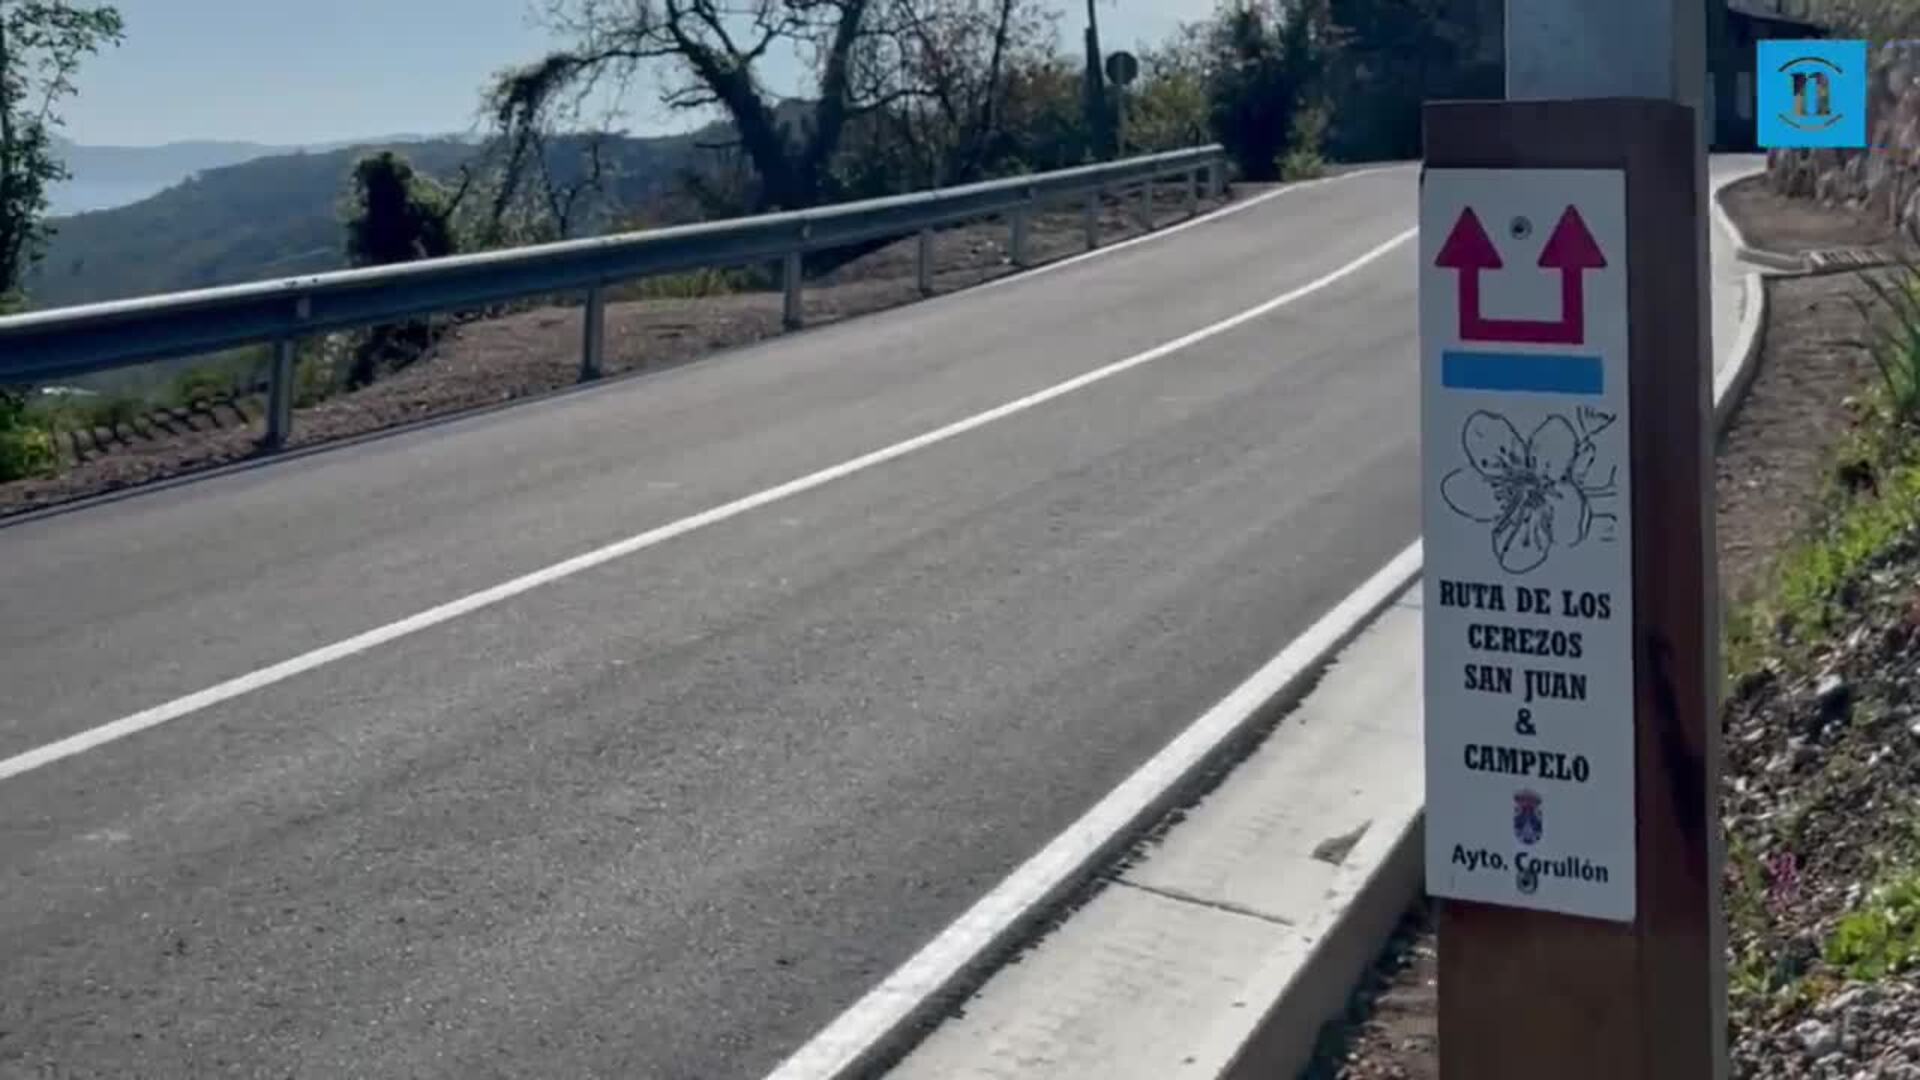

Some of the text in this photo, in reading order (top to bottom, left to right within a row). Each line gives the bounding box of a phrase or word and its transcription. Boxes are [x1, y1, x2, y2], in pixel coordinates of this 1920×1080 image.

[1440, 579, 1611, 619] RUTA DE LOS
[1468, 623, 1582, 658] CEREZOS
[1464, 664, 1587, 702] SAN JUAN
[1515, 708, 1536, 735] &
[1464, 744, 1589, 782] CAMPELO
[1452, 844, 1608, 883] Ayto. Corullón
